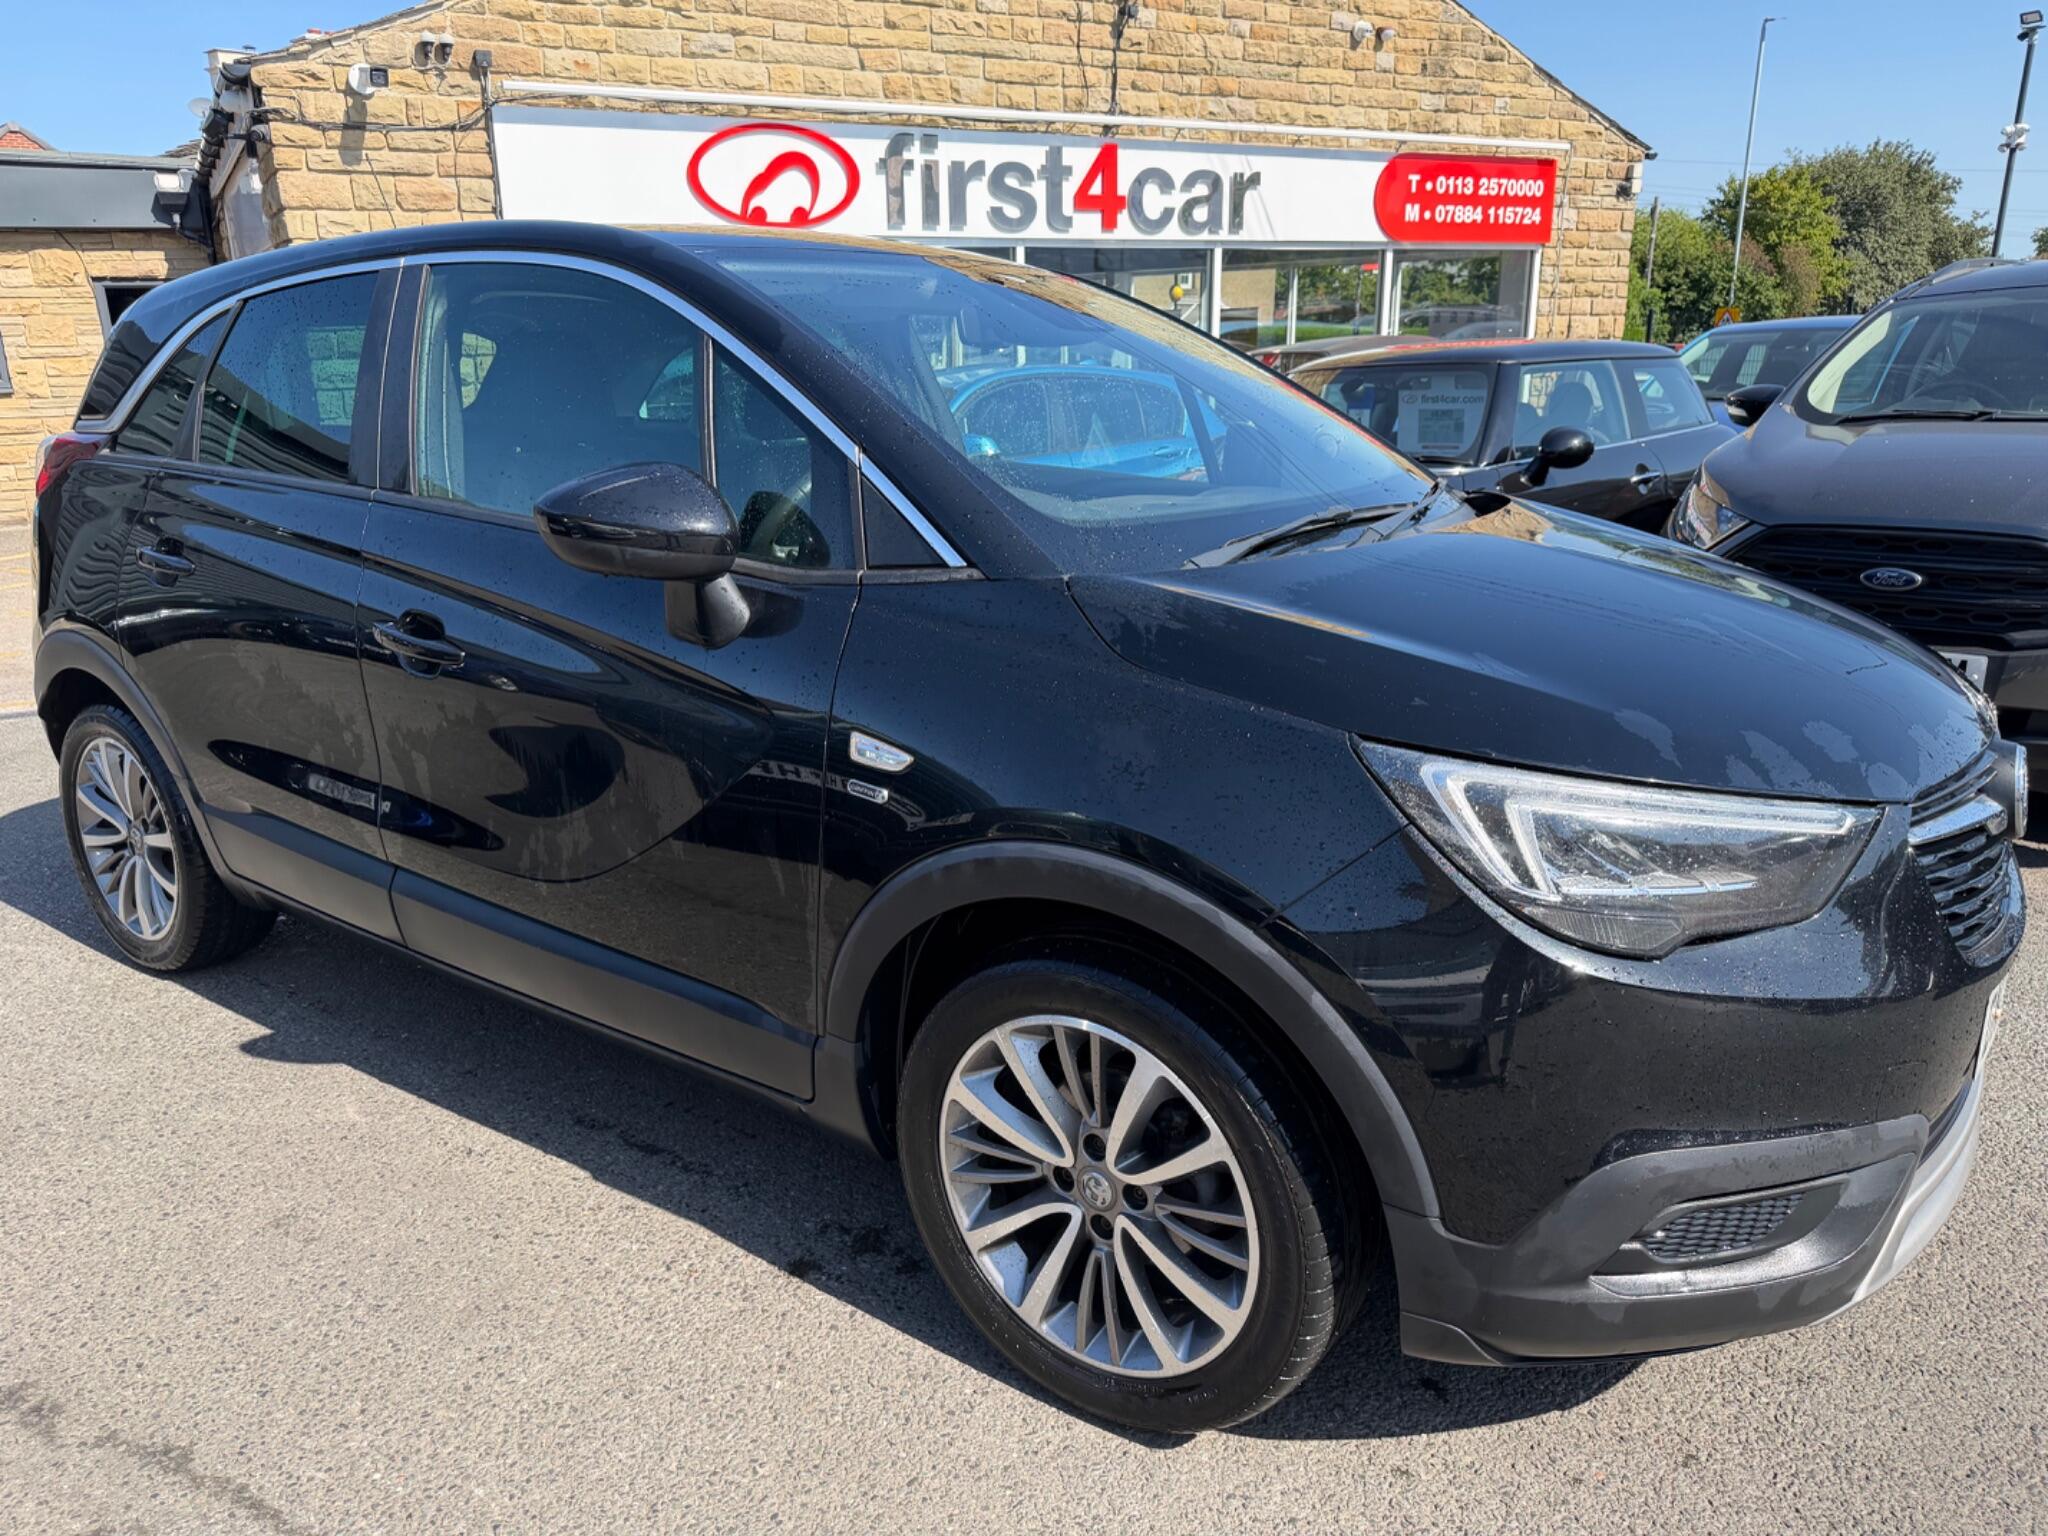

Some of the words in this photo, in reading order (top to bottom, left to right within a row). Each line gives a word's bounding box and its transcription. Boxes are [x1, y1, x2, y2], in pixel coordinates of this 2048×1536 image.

[876, 132, 1261, 235] first4car
[1408, 174, 1421, 193] T
[1436, 175, 1474, 195] 0113
[1478, 177, 1544, 197] 2570000
[1404, 203, 1420, 222] M
[1435, 204, 1483, 223] 07884
[1488, 206, 1541, 225] 115724
[1872, 572, 1907, 586] Ford
